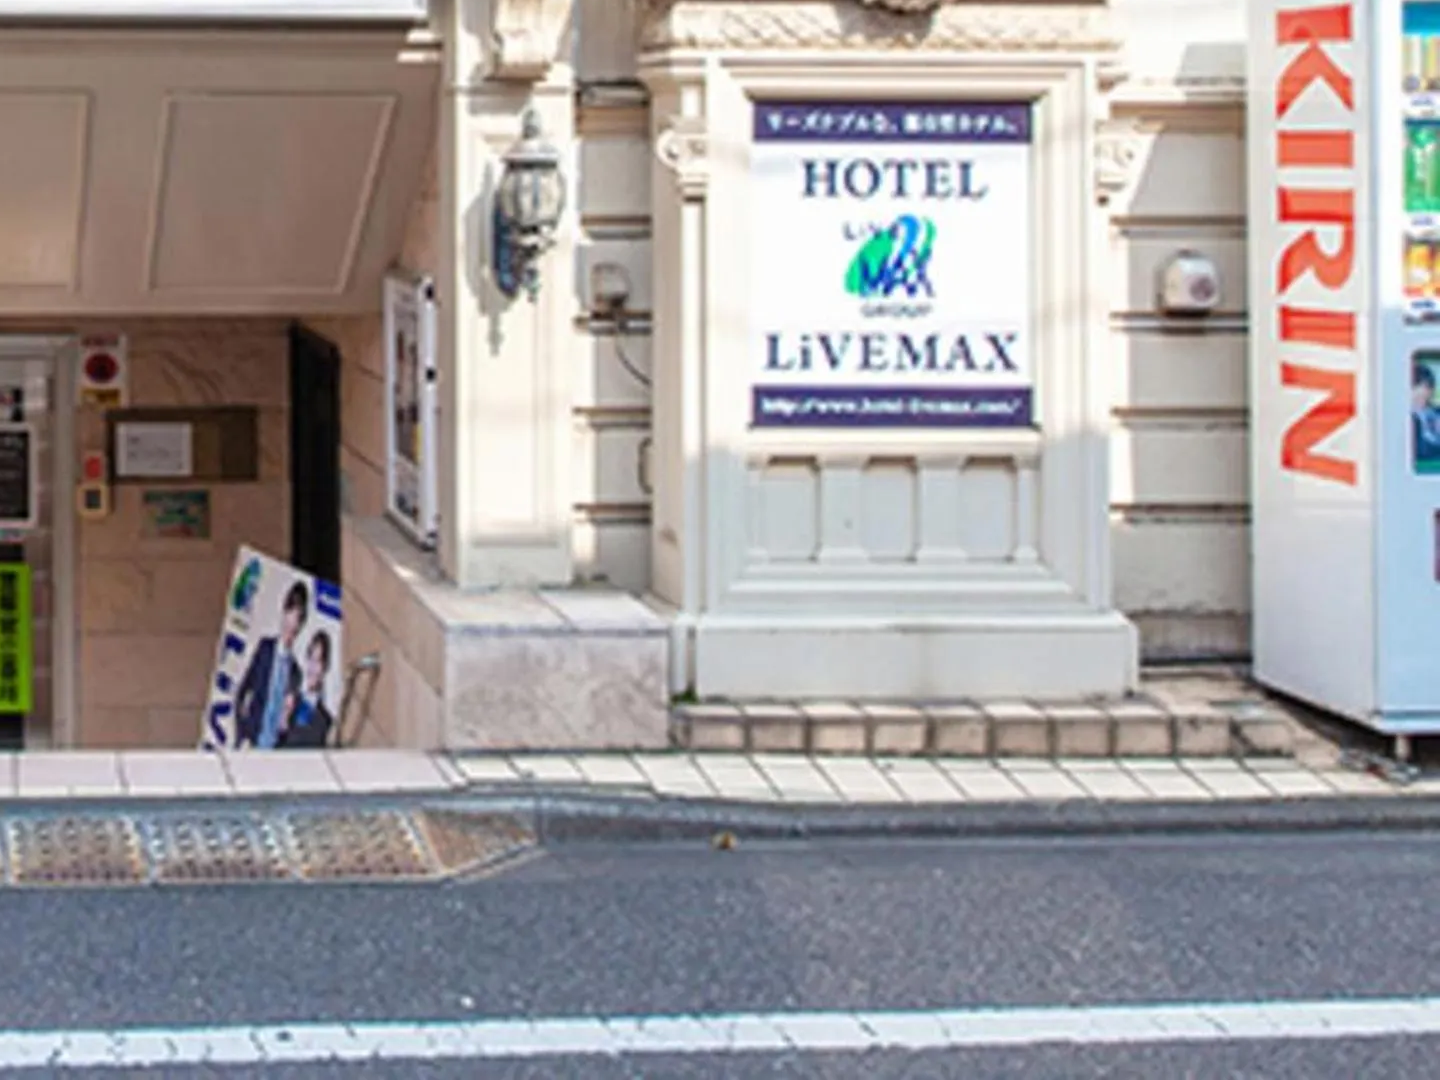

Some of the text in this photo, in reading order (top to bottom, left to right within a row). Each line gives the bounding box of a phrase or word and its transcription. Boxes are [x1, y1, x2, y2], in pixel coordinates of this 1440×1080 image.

[801, 158, 990, 200] HOTEL
[1276, 3, 1358, 486] KIRIN
[762, 331, 1020, 372] LiVEMAX
